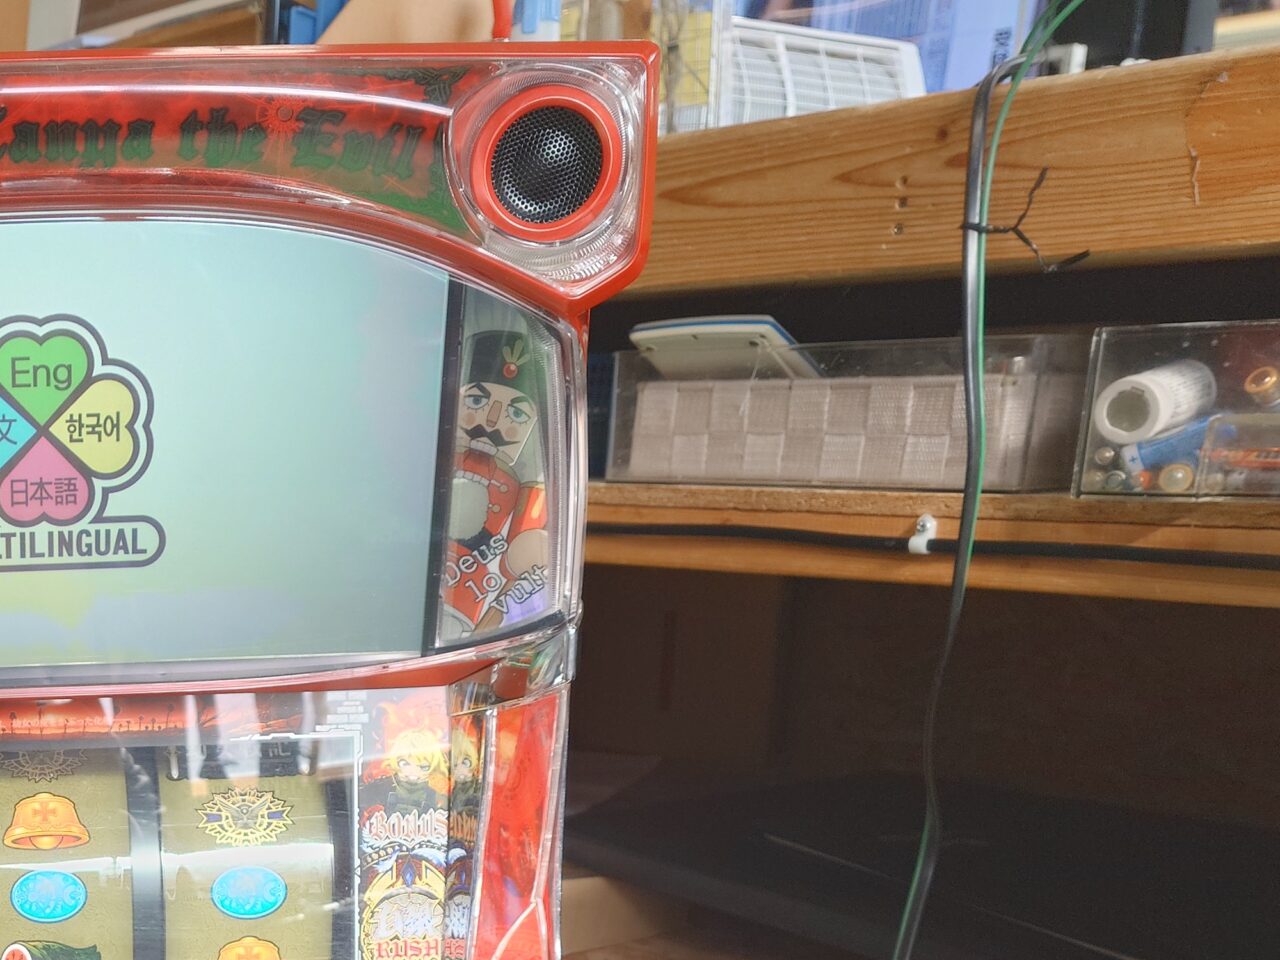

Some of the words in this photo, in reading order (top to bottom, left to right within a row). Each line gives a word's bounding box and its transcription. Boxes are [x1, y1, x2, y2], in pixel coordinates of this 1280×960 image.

[177, 107, 268, 169] the
[291, 108, 425, 180] Evil
[10, 356, 72, 391] Eng
[65, 411, 121, 443] 한국어
[10, 477, 78, 507] 日本語
[445, 534, 509, 587] Deus
[489, 563, 548, 614] vult
[370, 809, 448, 843] BONUS
